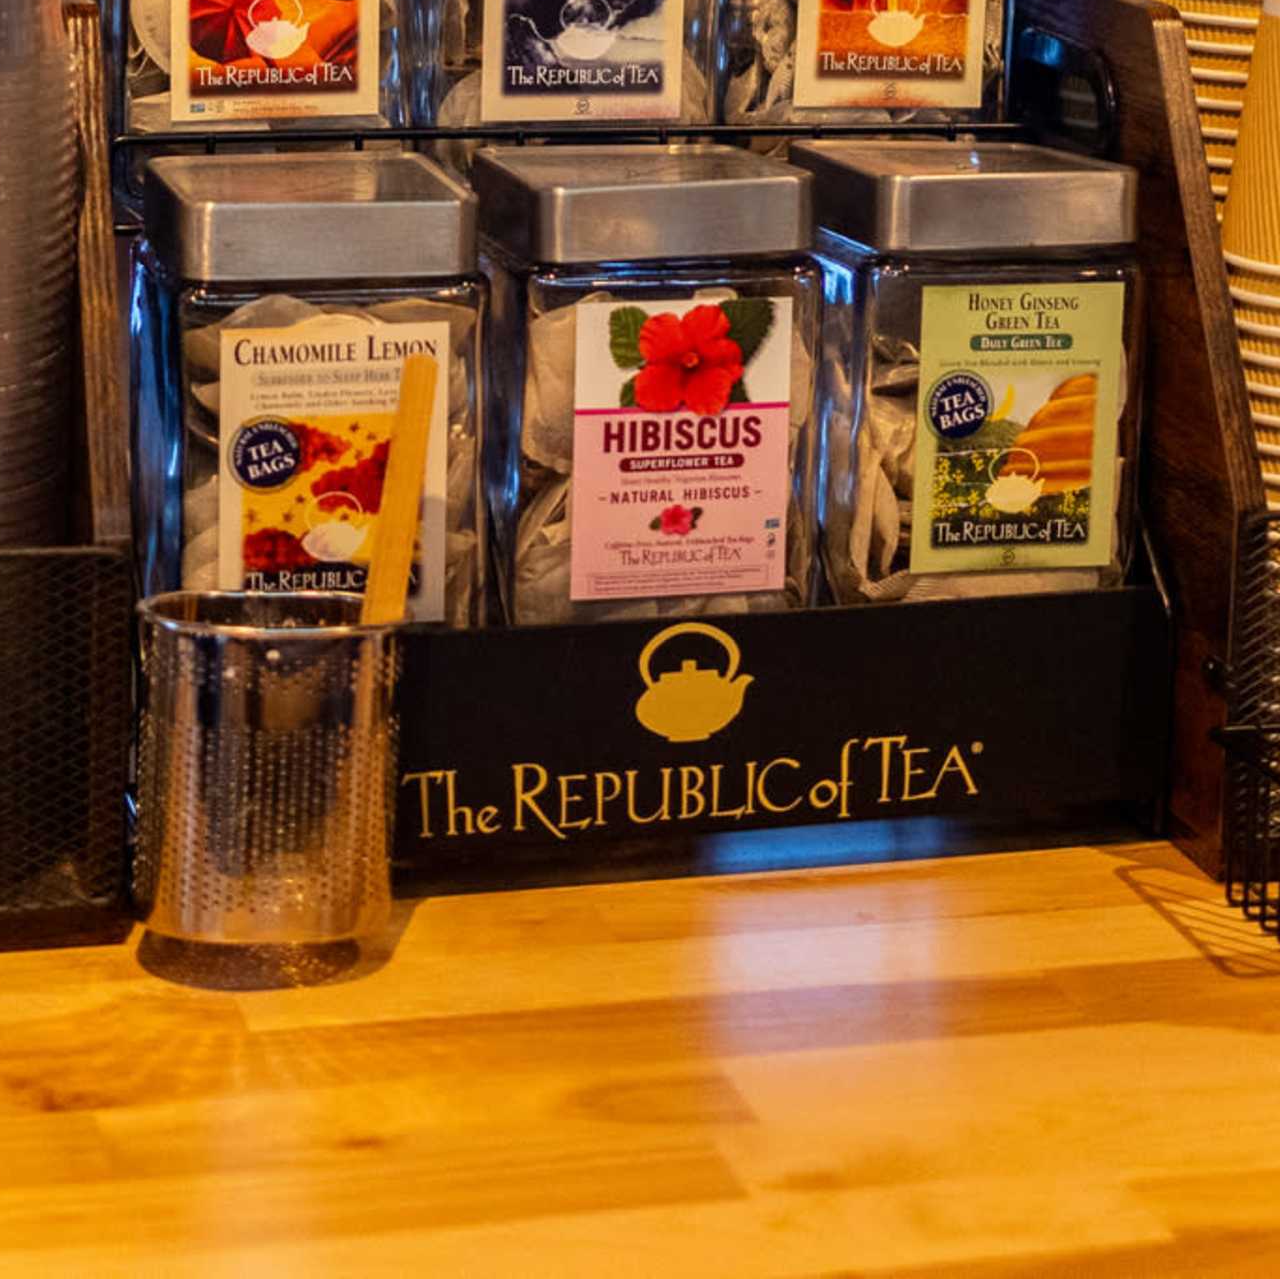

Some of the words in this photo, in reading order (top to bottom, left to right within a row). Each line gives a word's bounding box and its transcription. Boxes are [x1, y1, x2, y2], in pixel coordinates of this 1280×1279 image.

[821, 51, 846, 71] The
[847, 51, 919, 74] REPUBLIC
[920, 53, 932, 74] of
[933, 53, 963, 72] TEA
[197, 67, 223, 86] The
[226, 65, 305, 88] REPUBLIC
[306, 63, 318, 85] of
[320, 61, 353, 82] TEA
[507, 66, 534, 86] The
[536, 65, 612, 87] REPUBLIC
[613, 64, 626, 87] of
[628, 63, 660, 83] TEA
[968, 293, 1015, 311] HONEY
[1020, 293, 1080, 311] GINSENG
[985, 311, 1030, 330] GREEN
[1035, 311, 1060, 330] TEA
[234, 338, 357, 365] CHAMOMILE
[367, 335, 438, 362] LEMON
[940, 391, 974, 412] TEA
[940, 404, 985, 430] BAGS
[603, 416, 762, 453] HIBISCUS
[247, 440, 283, 460] TEA
[247, 453, 296, 480] BAGS
[629, 457, 709, 469] SUPERFLOWER
[714, 455, 734, 466] TEA
[610, 488, 674, 504] NATURAL
[683, 485, 751, 501] HIBISCUS
[935, 523, 960, 542] The
[963, 521, 1039, 544] REPUBLIC
[1039, 520, 1052, 541] of
[1054, 519, 1086, 538] TEA
[620, 550, 640, 566] The
[642, 548, 703, 566] REPUBLIC
[246, 571, 277, 591] The
[278, 570, 365, 592] REPUBLIC
[401, 769, 501, 838] The
[511, 757, 800, 839] REPUBLIC
[808, 738, 858, 818] of
